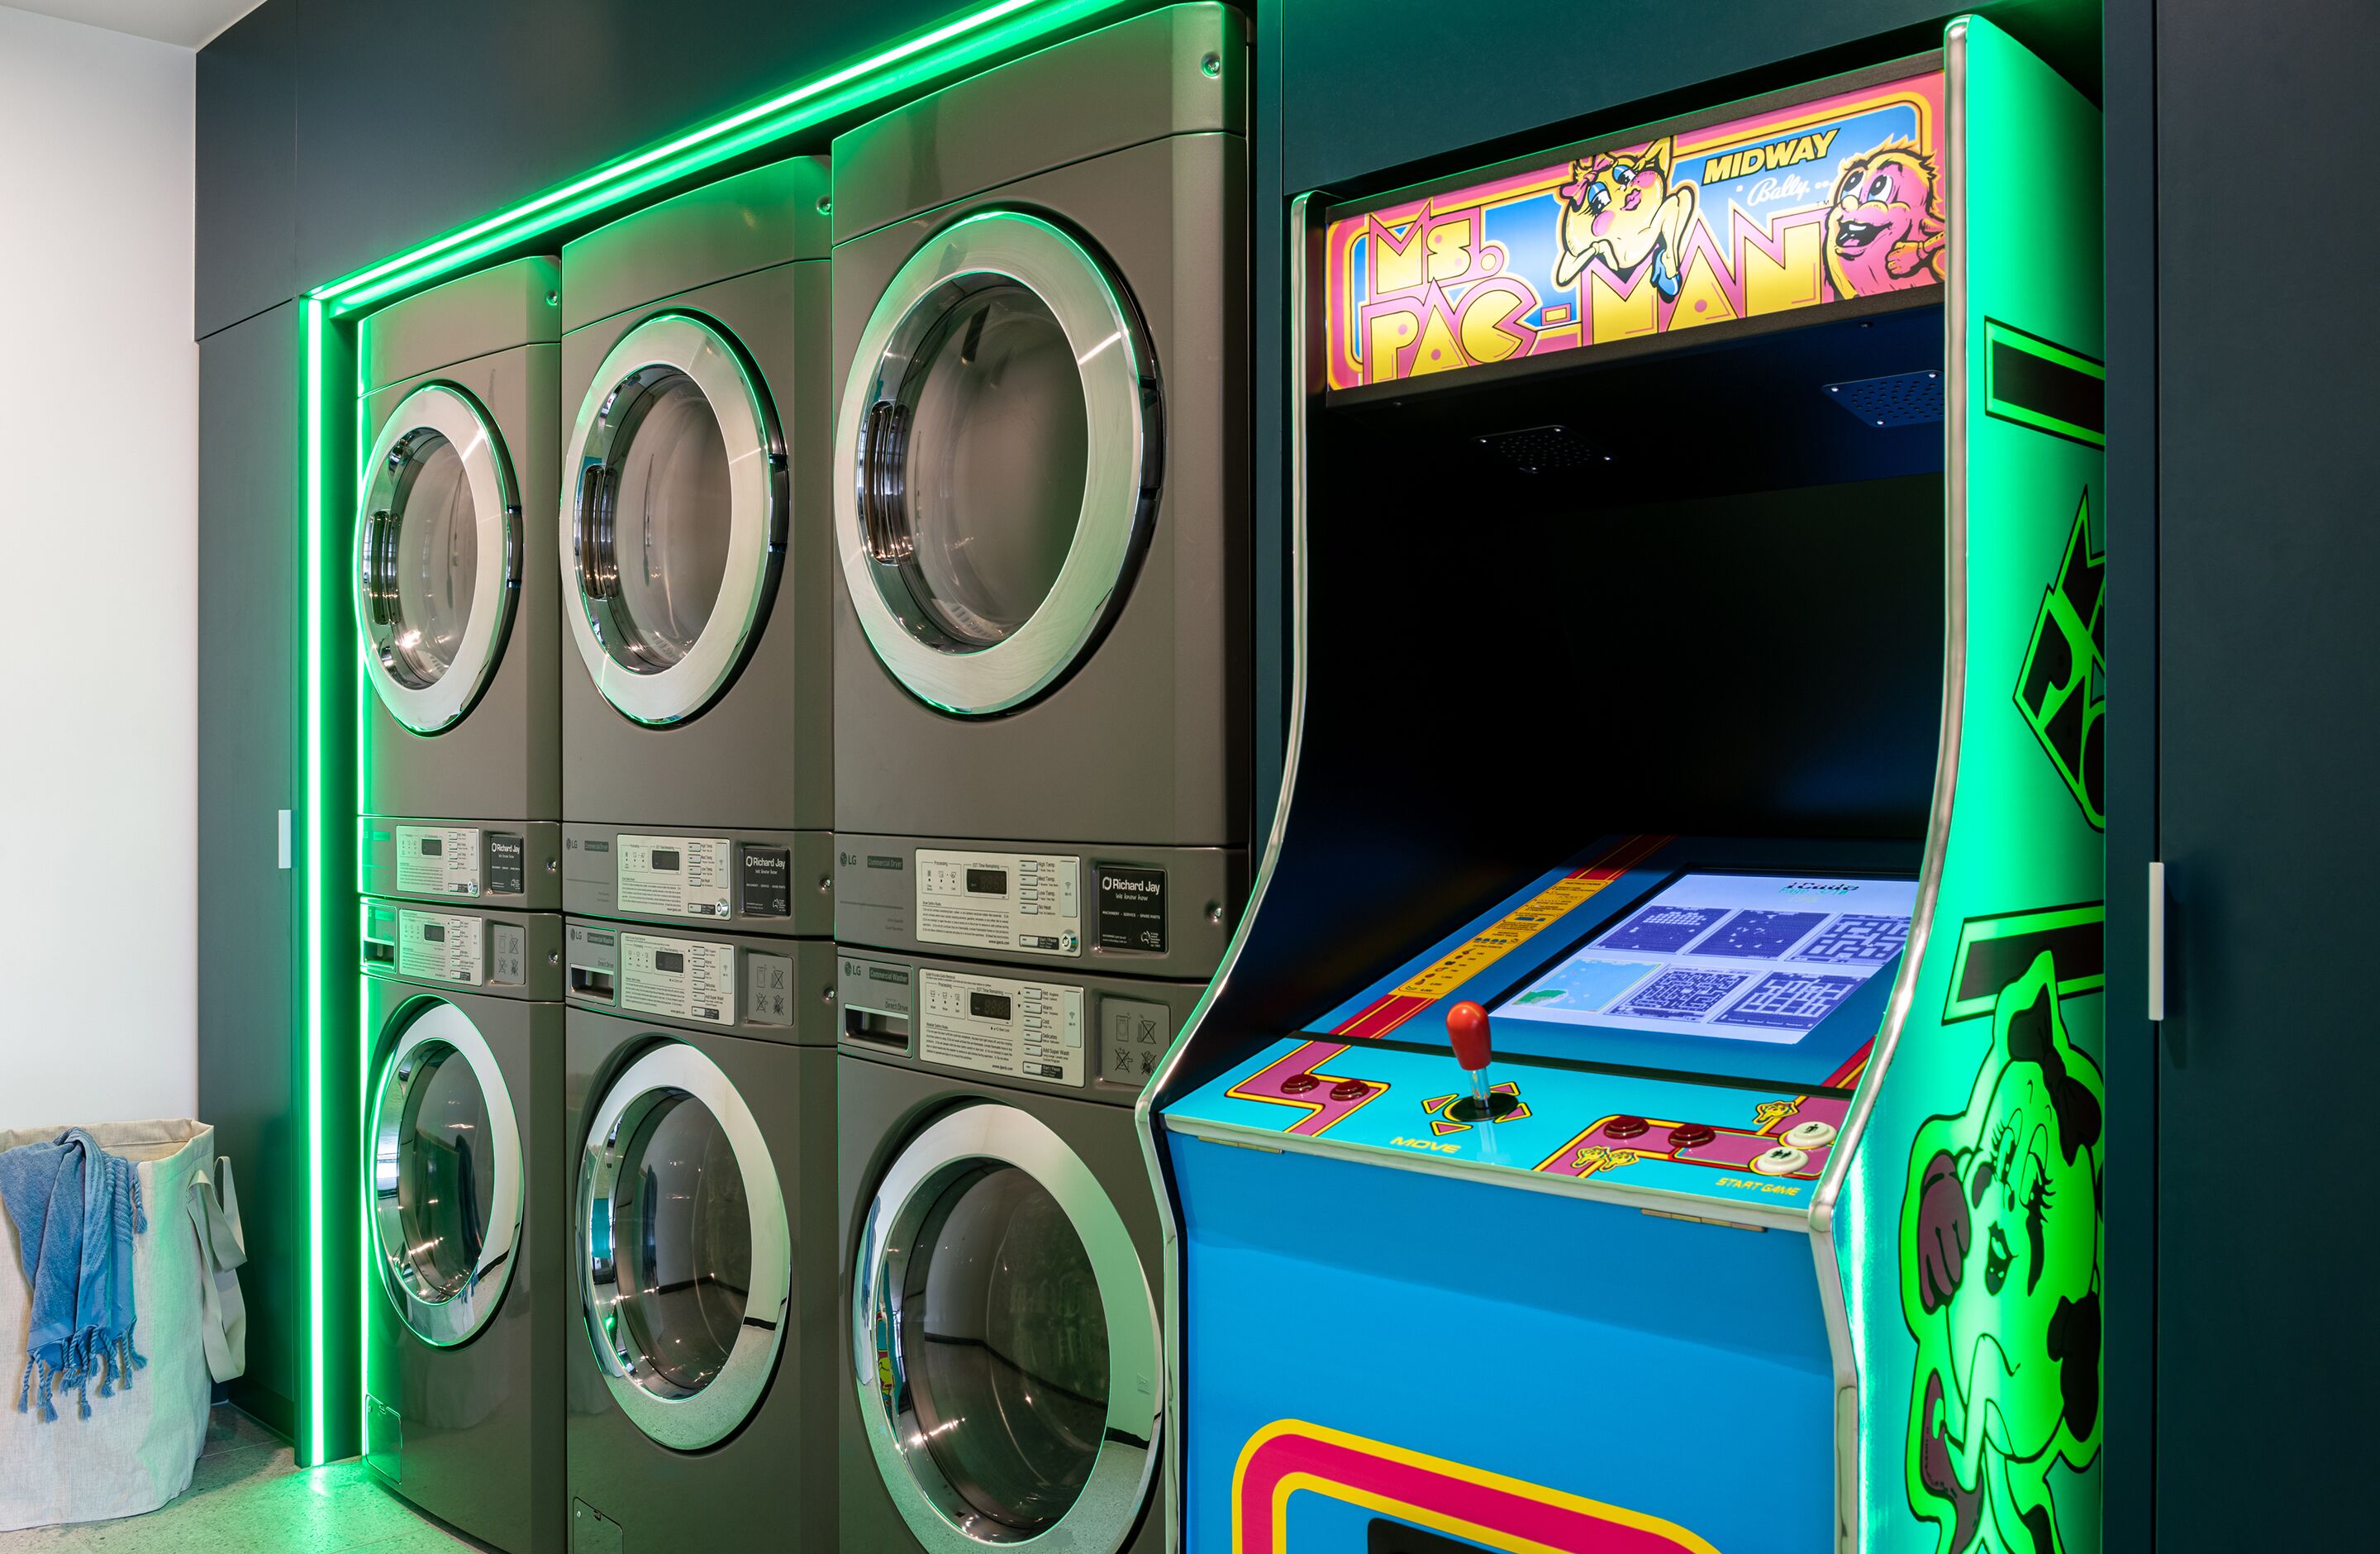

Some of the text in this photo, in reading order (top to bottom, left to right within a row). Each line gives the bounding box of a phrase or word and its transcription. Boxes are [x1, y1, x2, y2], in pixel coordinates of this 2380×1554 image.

[1702, 127, 1841, 186] MIDWAY
[1370, 203, 1504, 303] MS.
[1362, 203, 1825, 384] PAC-MAN
[754, 857, 785, 870] Richard Jay
[848, 855, 857, 865] LG
[1112, 878, 1160, 895] Richard Jay
[853, 965, 861, 976] LG
[1390, 1137, 1461, 1154] MOVE
[1716, 1177, 1802, 1196] START GAME
